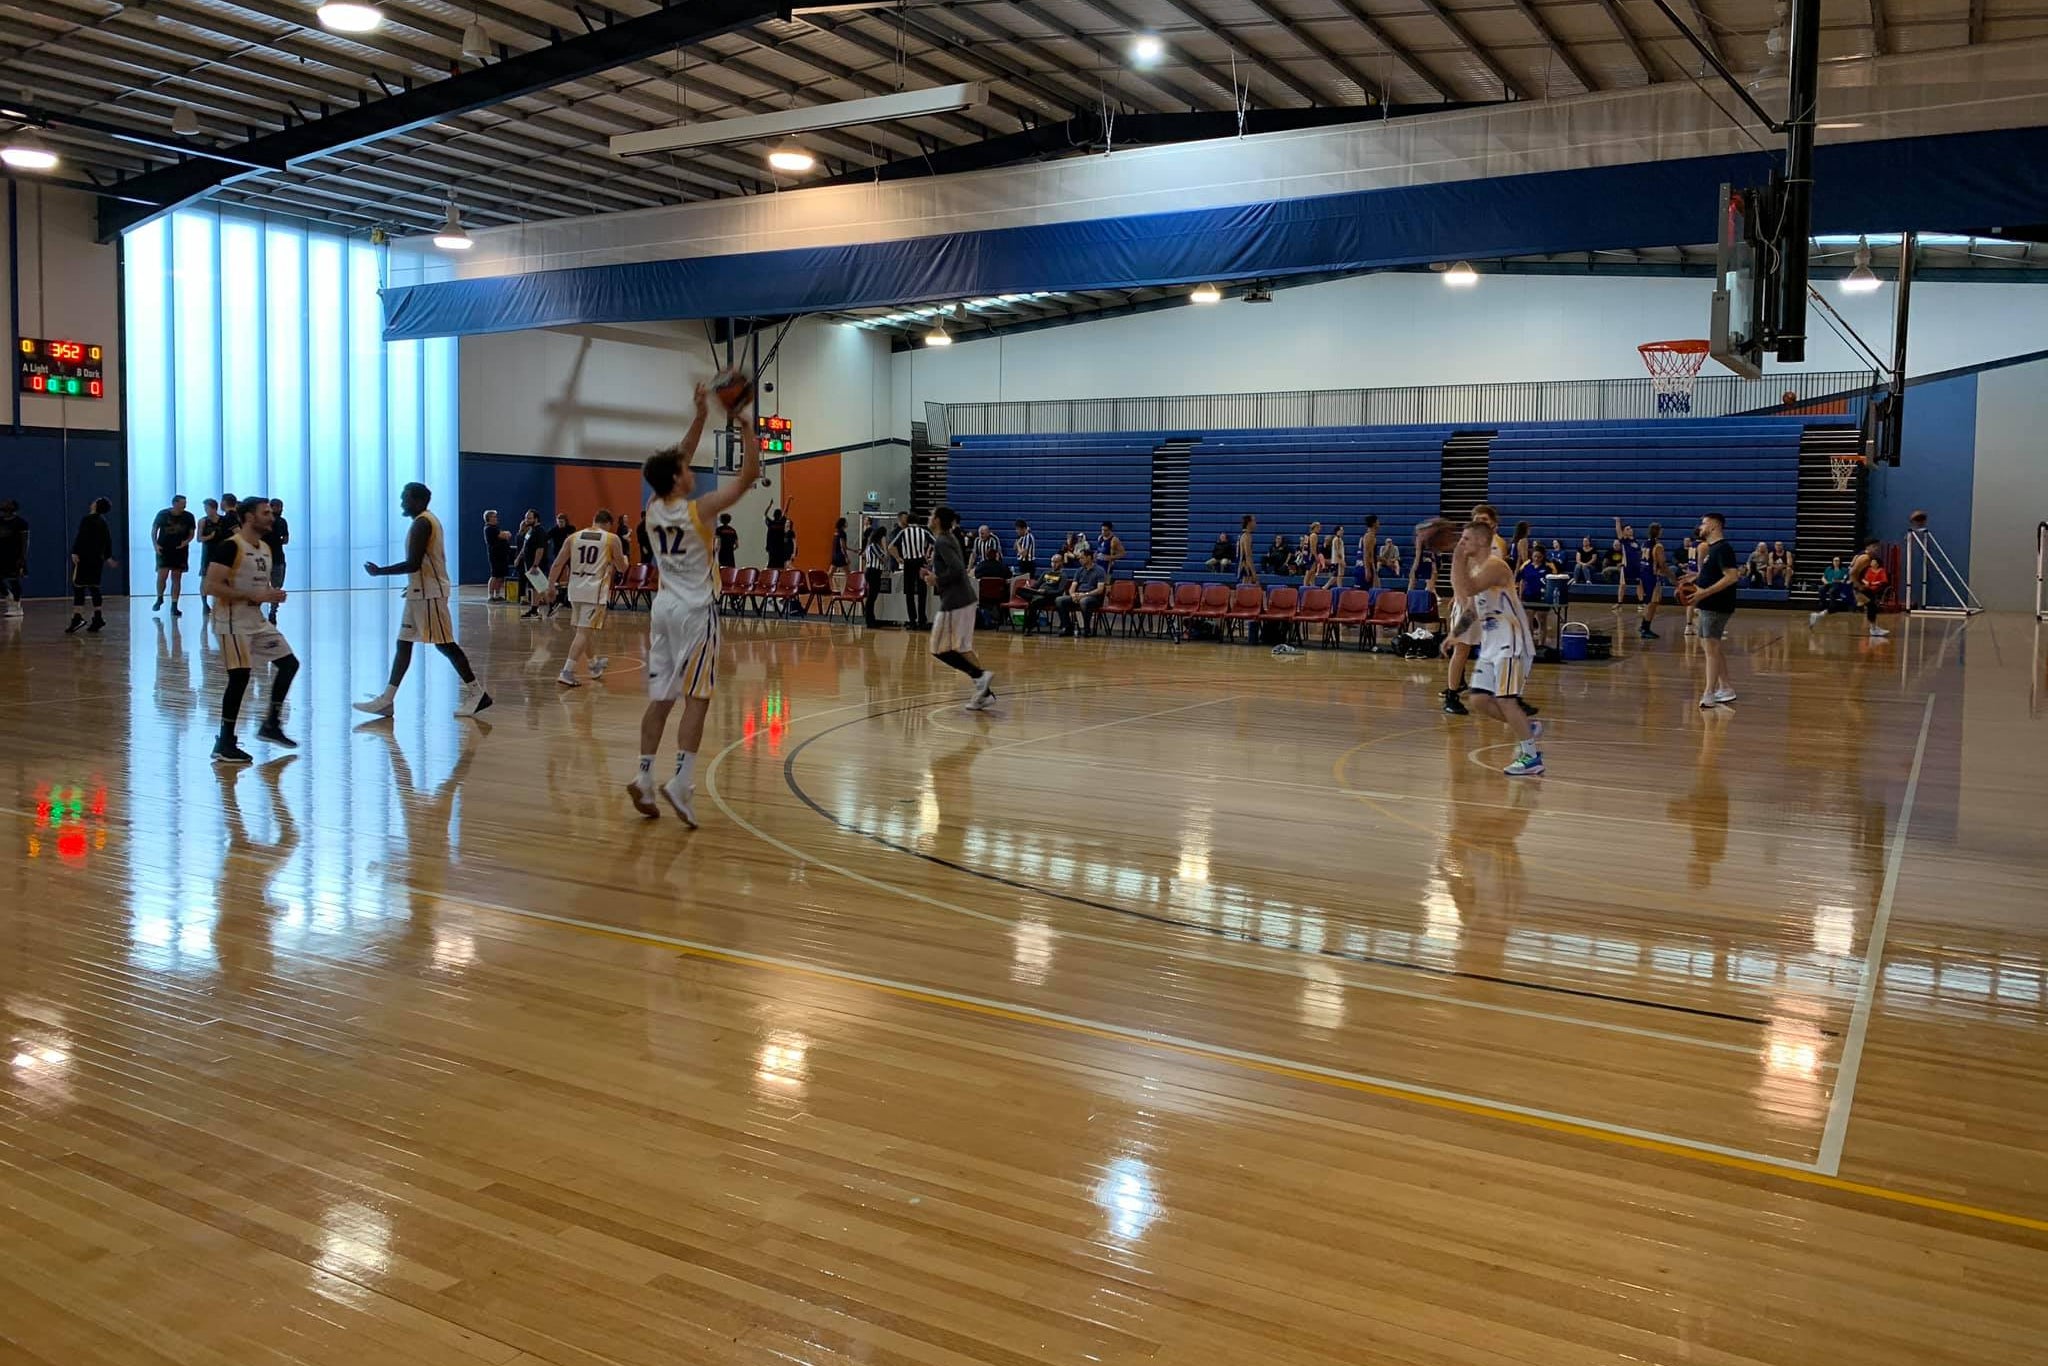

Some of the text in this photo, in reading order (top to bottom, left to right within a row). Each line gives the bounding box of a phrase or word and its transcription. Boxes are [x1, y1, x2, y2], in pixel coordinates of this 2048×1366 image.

[22, 340, 31, 352] 0
[91, 347, 100, 359] 0
[22, 363, 49, 375] A Light
[76, 368, 82, 377] B
[83, 369, 100, 378] Dark
[33, 376, 43, 390] 0
[47, 379, 77, 393] 0 0
[90, 381, 100, 395] 0
[653, 525, 687, 555] 12
[577, 545, 599, 565] 10
